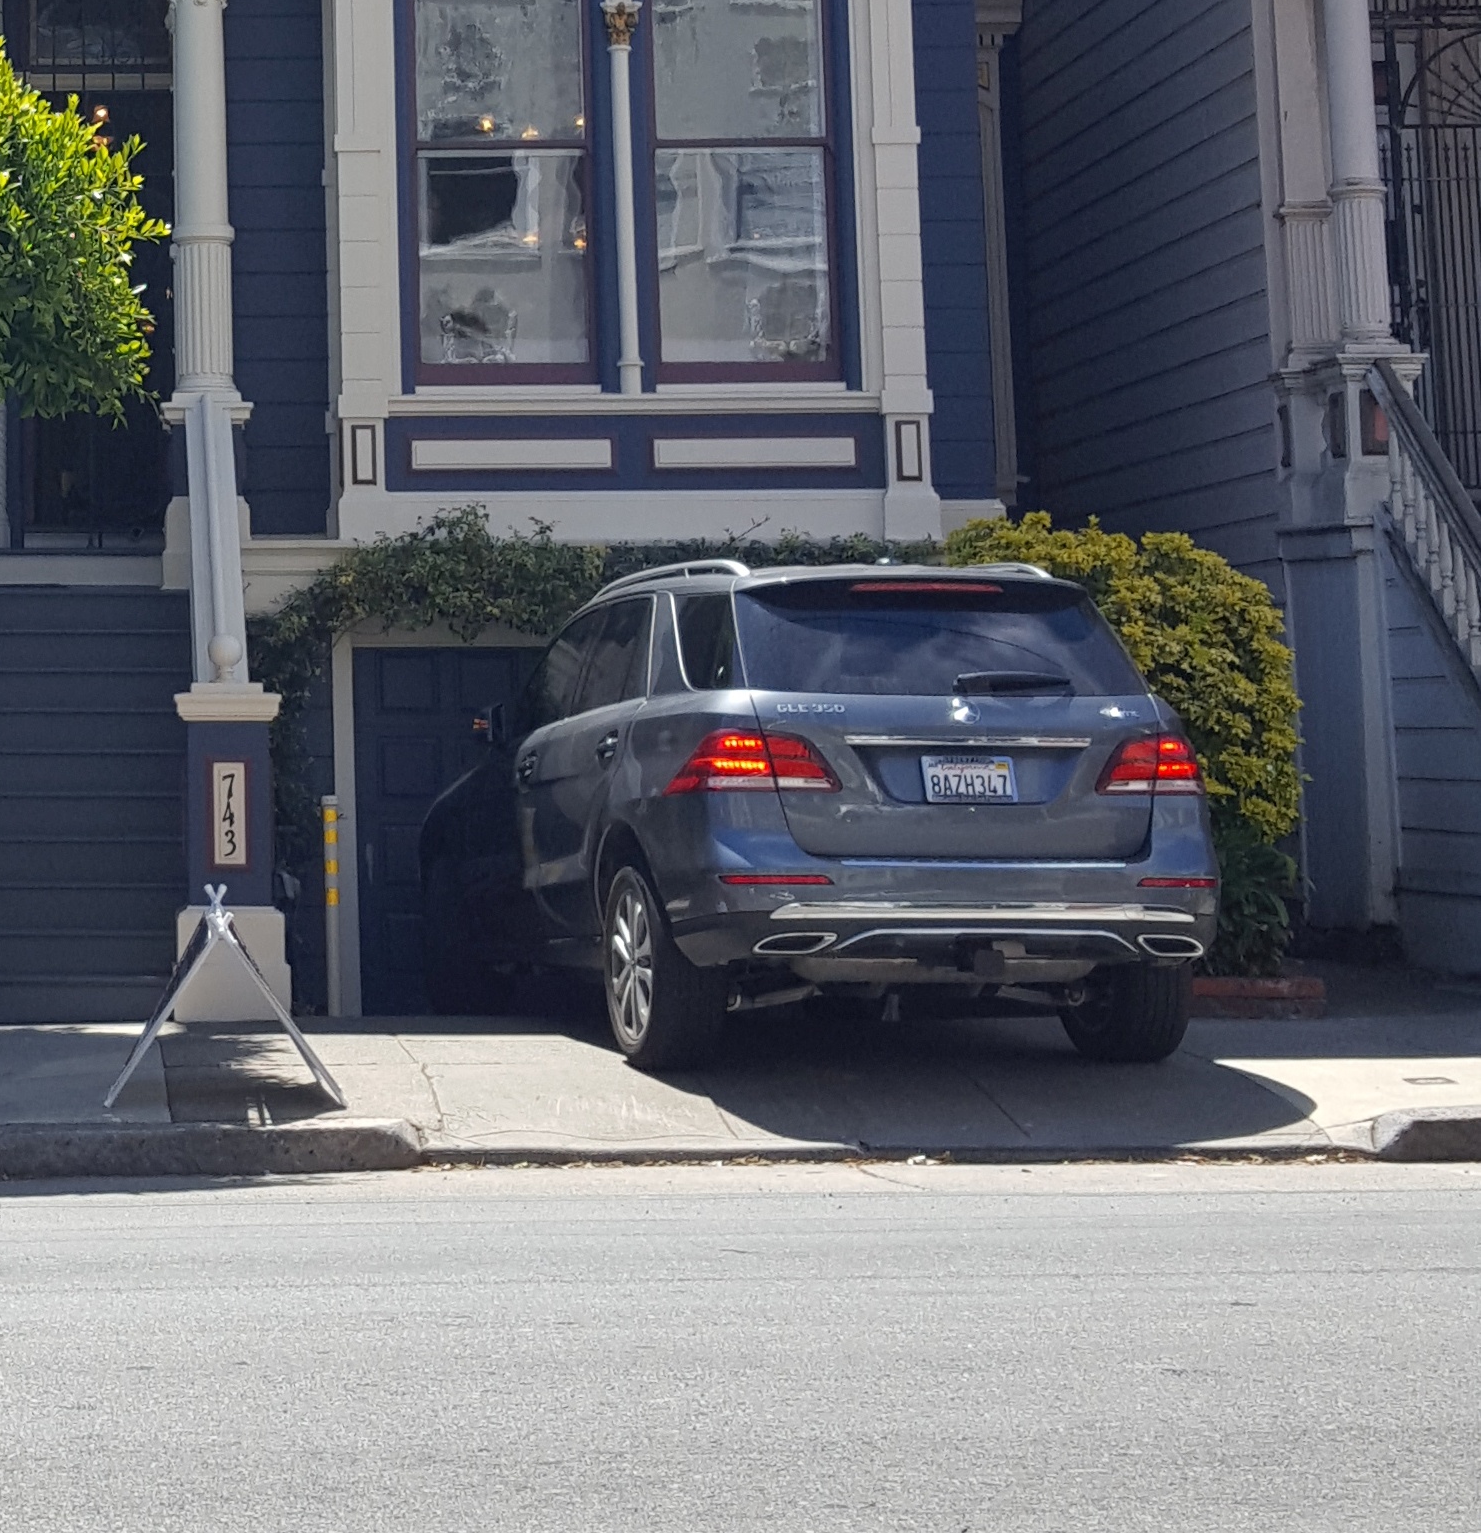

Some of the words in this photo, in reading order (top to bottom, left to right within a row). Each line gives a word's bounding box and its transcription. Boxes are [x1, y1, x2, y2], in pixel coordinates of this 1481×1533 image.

[777, 703, 809, 714] GLE
[812, 703, 846, 714] 350
[930, 774, 1008, 796] 8AZH347
[221, 772, 238, 858] 743
